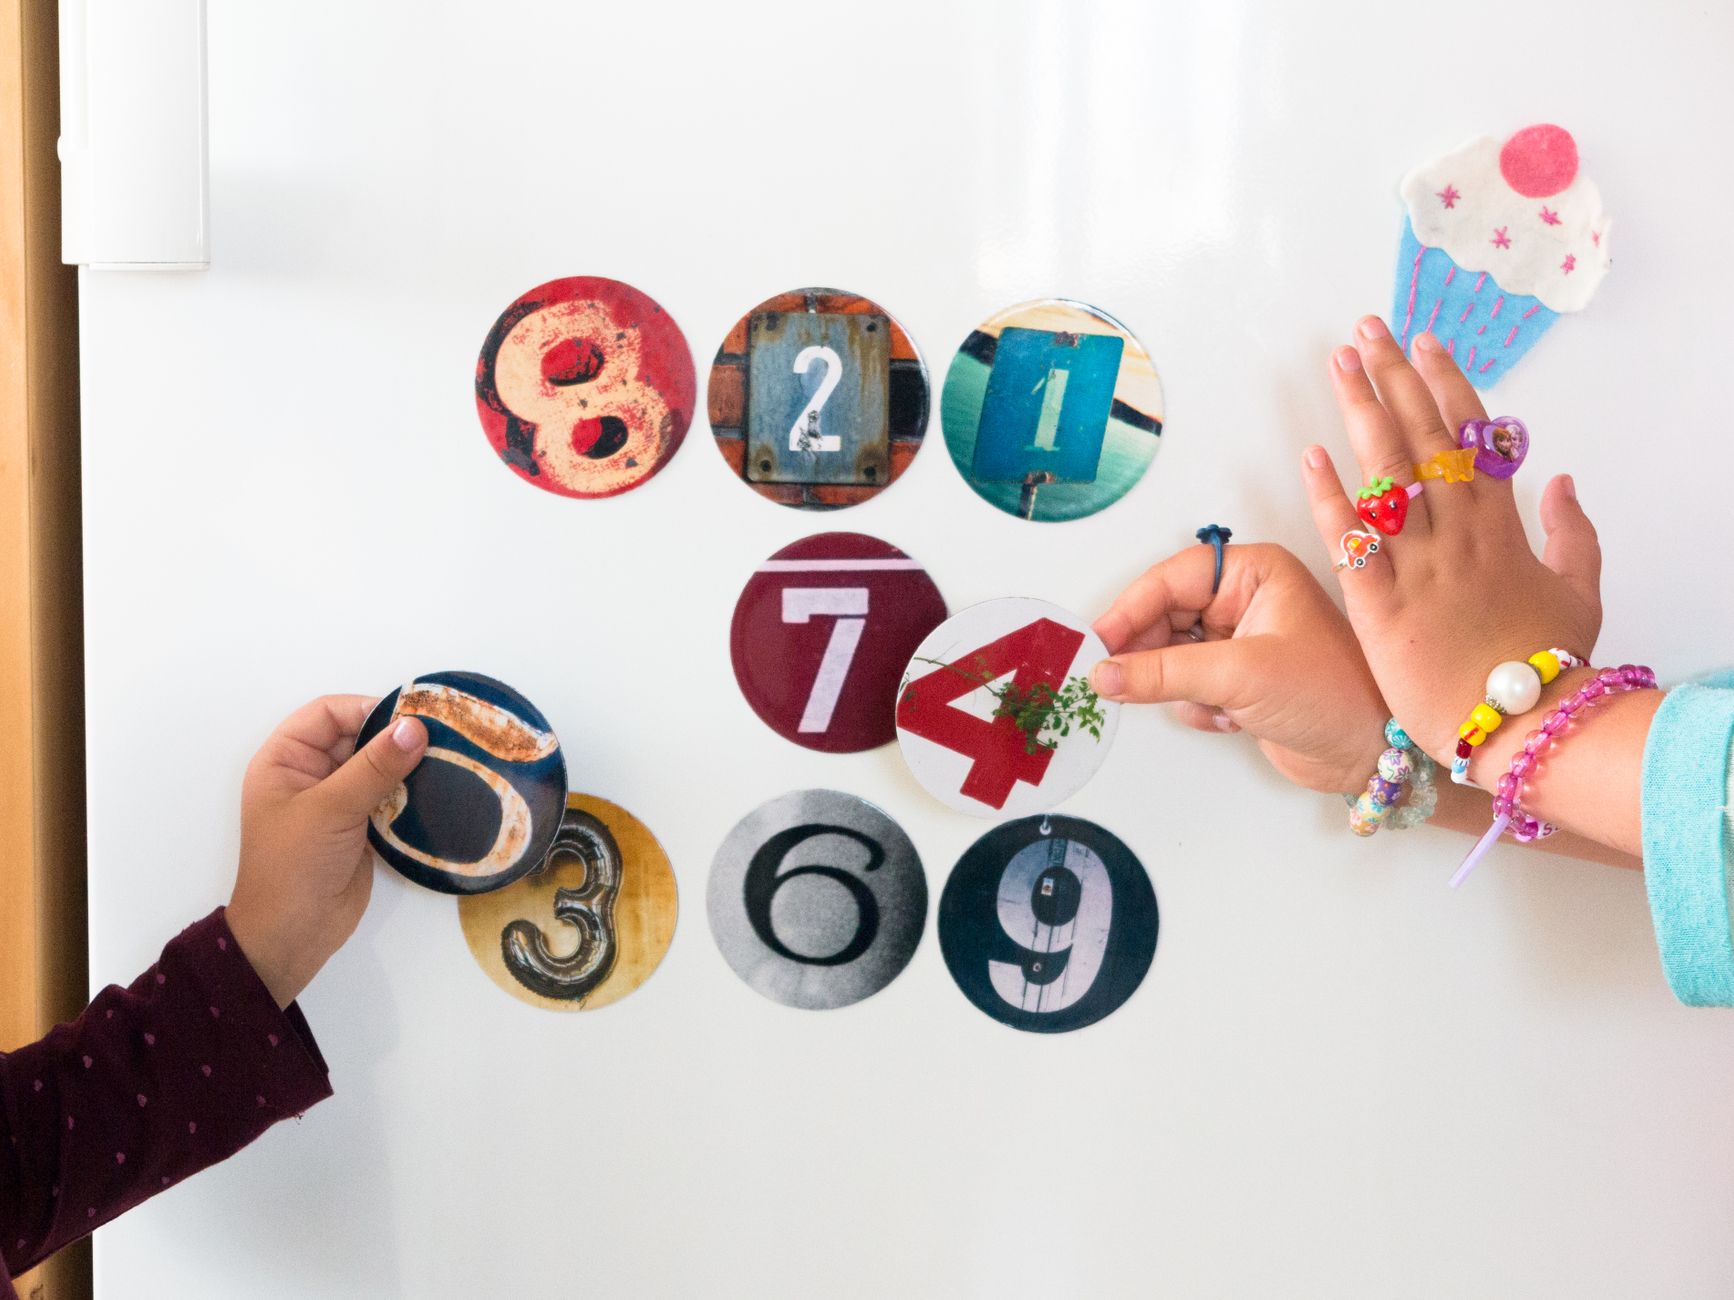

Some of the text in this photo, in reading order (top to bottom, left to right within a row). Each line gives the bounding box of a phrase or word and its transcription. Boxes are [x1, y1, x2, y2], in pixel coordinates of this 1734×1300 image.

[494, 299, 671, 494] 8
[789, 345, 843, 452] 2
[1023, 369, 1069, 452] 1
[782, 588, 869, 733] 7
[896, 617, 1085, 811] 4
[501, 807, 624, 1001] 3
[743, 823, 885, 967] 6
[988, 838, 1112, 1013] 9
